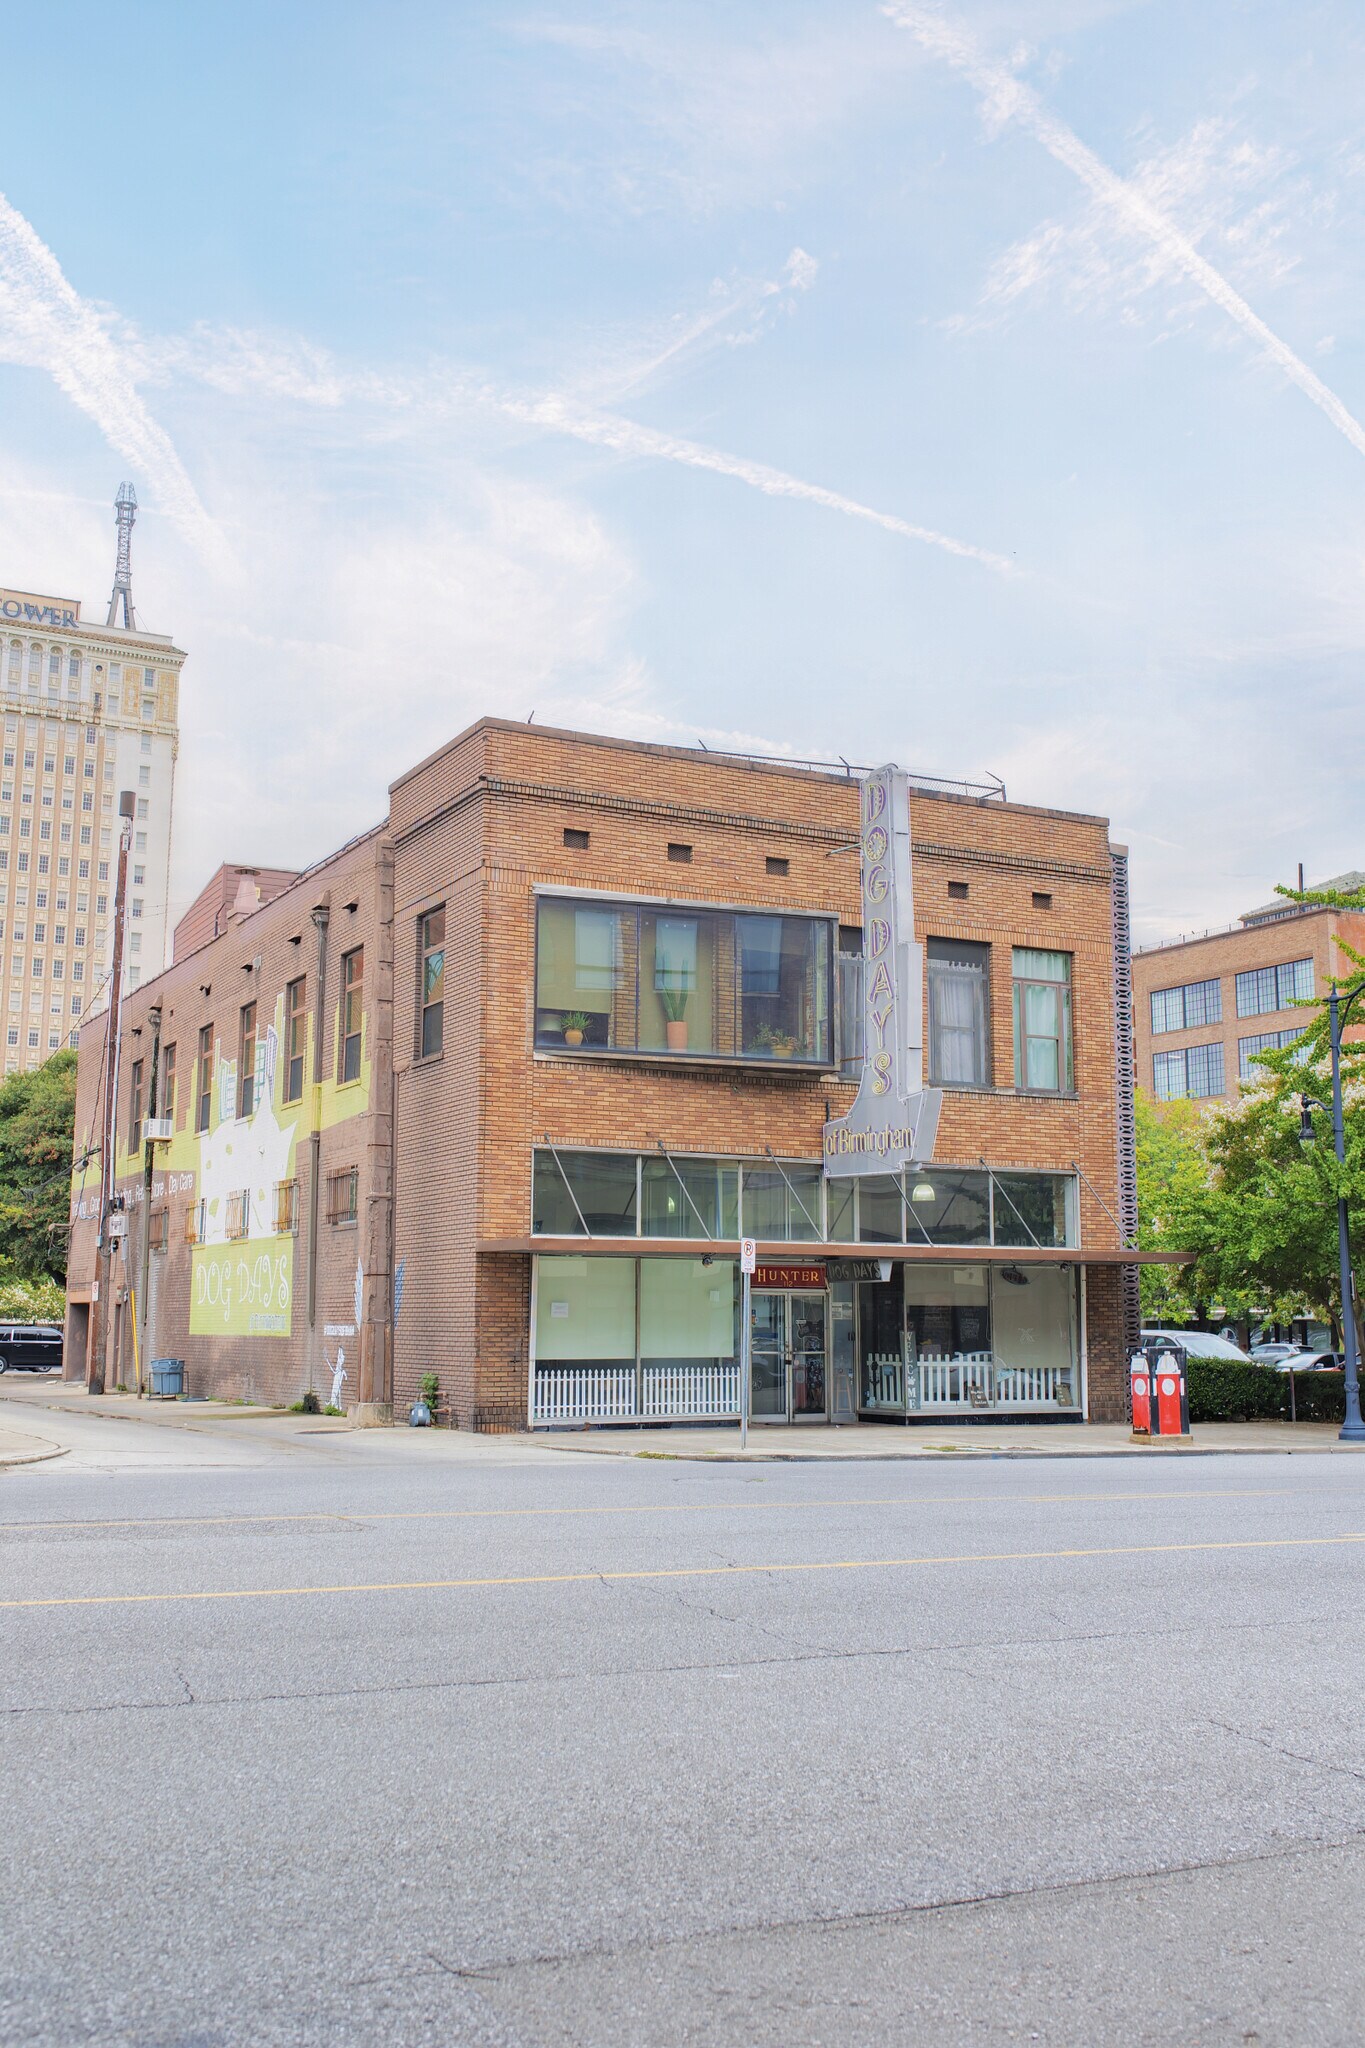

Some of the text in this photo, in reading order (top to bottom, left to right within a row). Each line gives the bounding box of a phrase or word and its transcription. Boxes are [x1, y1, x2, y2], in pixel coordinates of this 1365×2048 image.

[0, 599, 79, 628] OWER
[864, 783, 893, 1096] DOG DAYS
[825, 1123, 915, 1157] of Birmingham
[180, 1173, 193, 1191] Care
[757, 1268, 820, 1282] HUNTER
[829, 1261, 881, 1279] DOG DAYS
[196, 1254, 289, 1322] DOG DAYS
